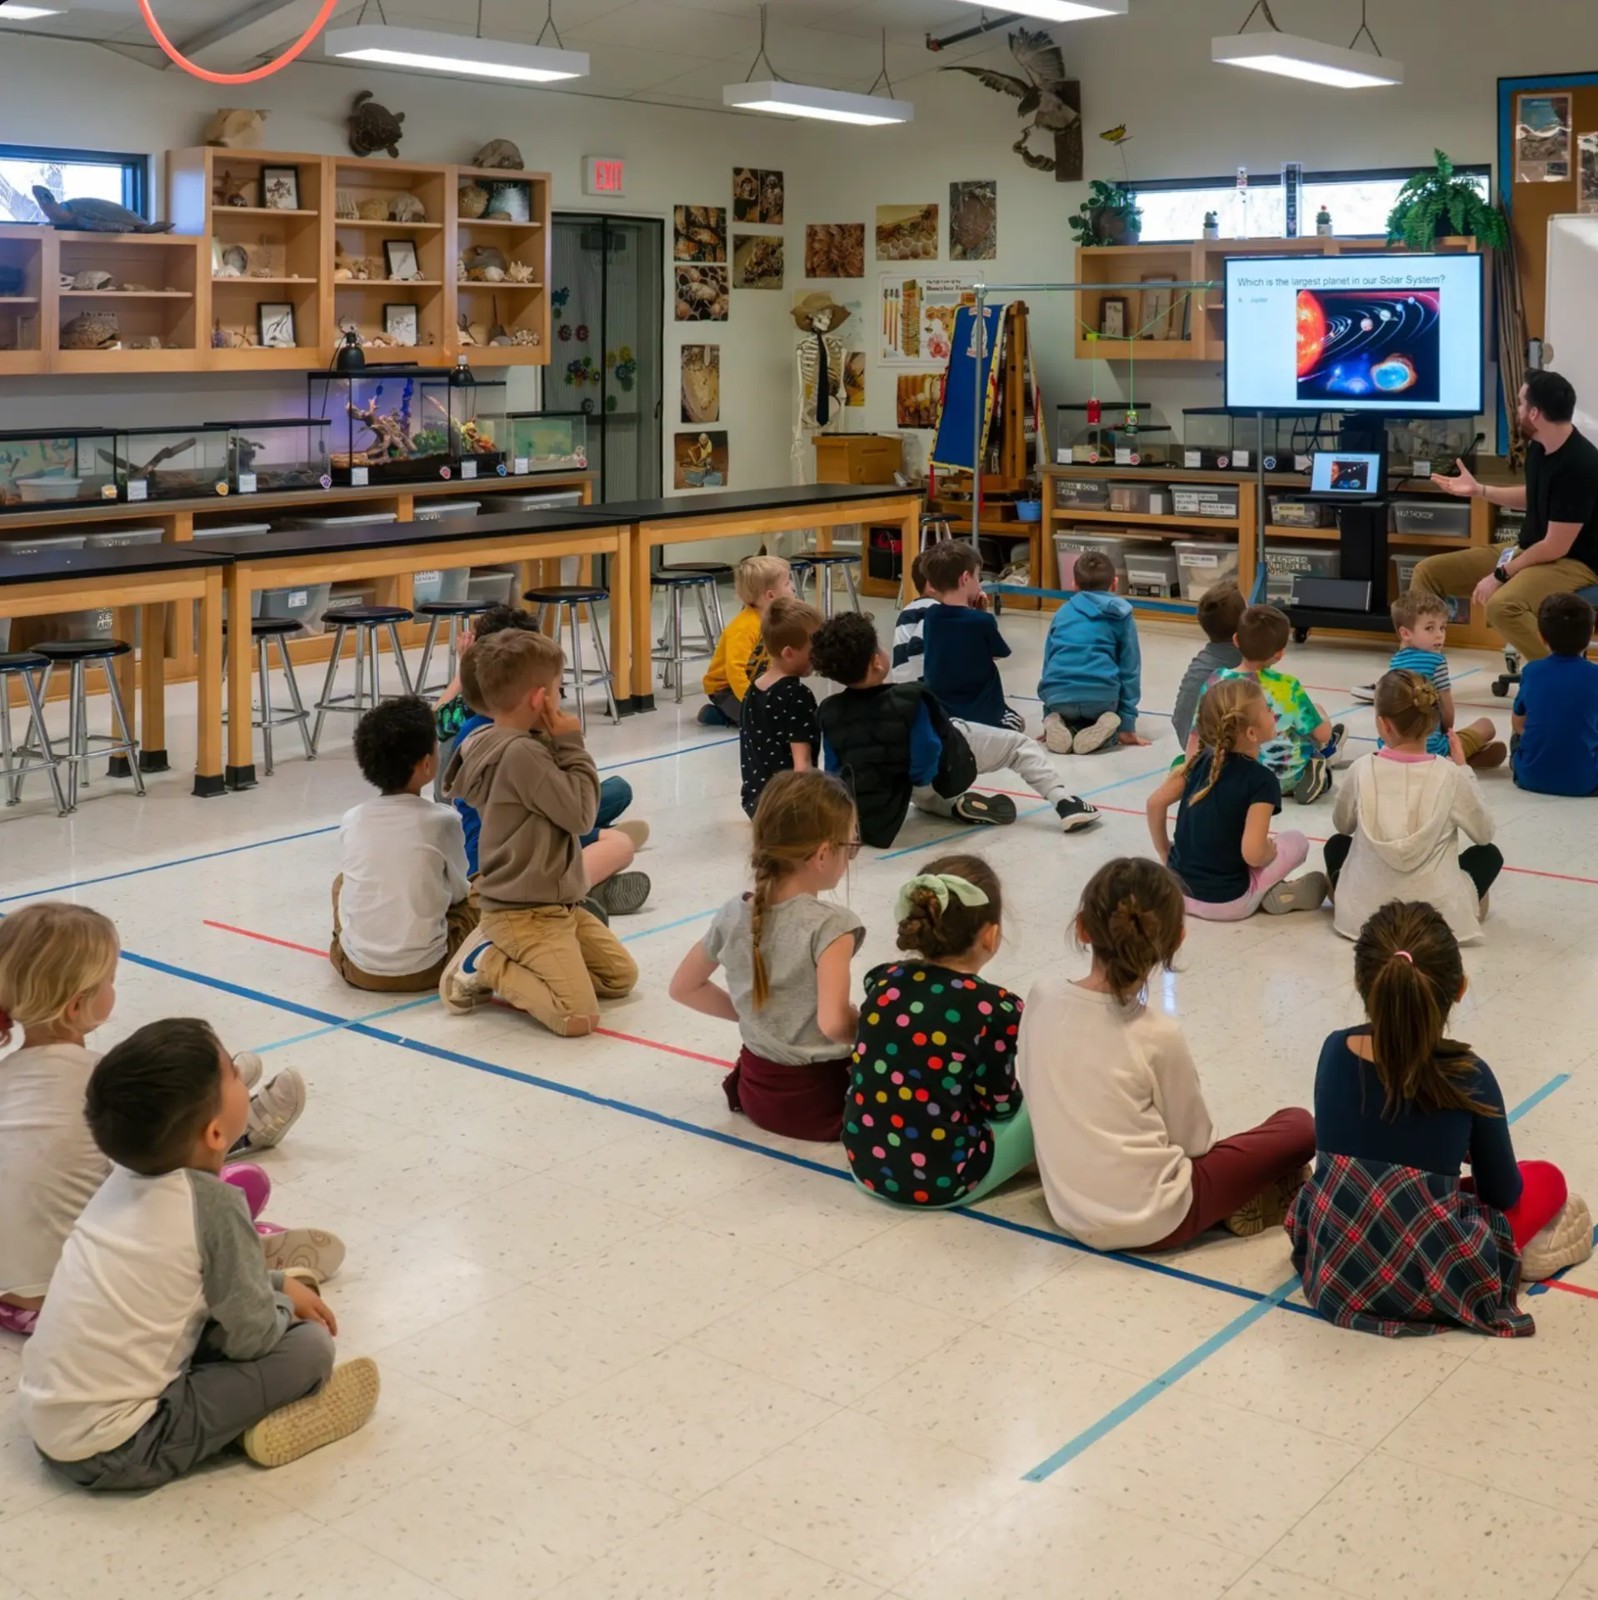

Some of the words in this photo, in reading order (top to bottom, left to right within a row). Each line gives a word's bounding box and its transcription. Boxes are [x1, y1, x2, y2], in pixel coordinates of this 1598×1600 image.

[595, 160, 624, 191] EXIT
[1237, 277, 1264, 286] Which
[1266, 277, 1274, 286] is
[1275, 277, 1289, 286] the
[1291, 276, 1320, 287] largest
[1323, 276, 1350, 287] planet
[1352, 276, 1360, 285] in
[1362, 277, 1376, 285] our
[1380, 275, 1403, 284] Solar
[1406, 274, 1446, 286] System?
